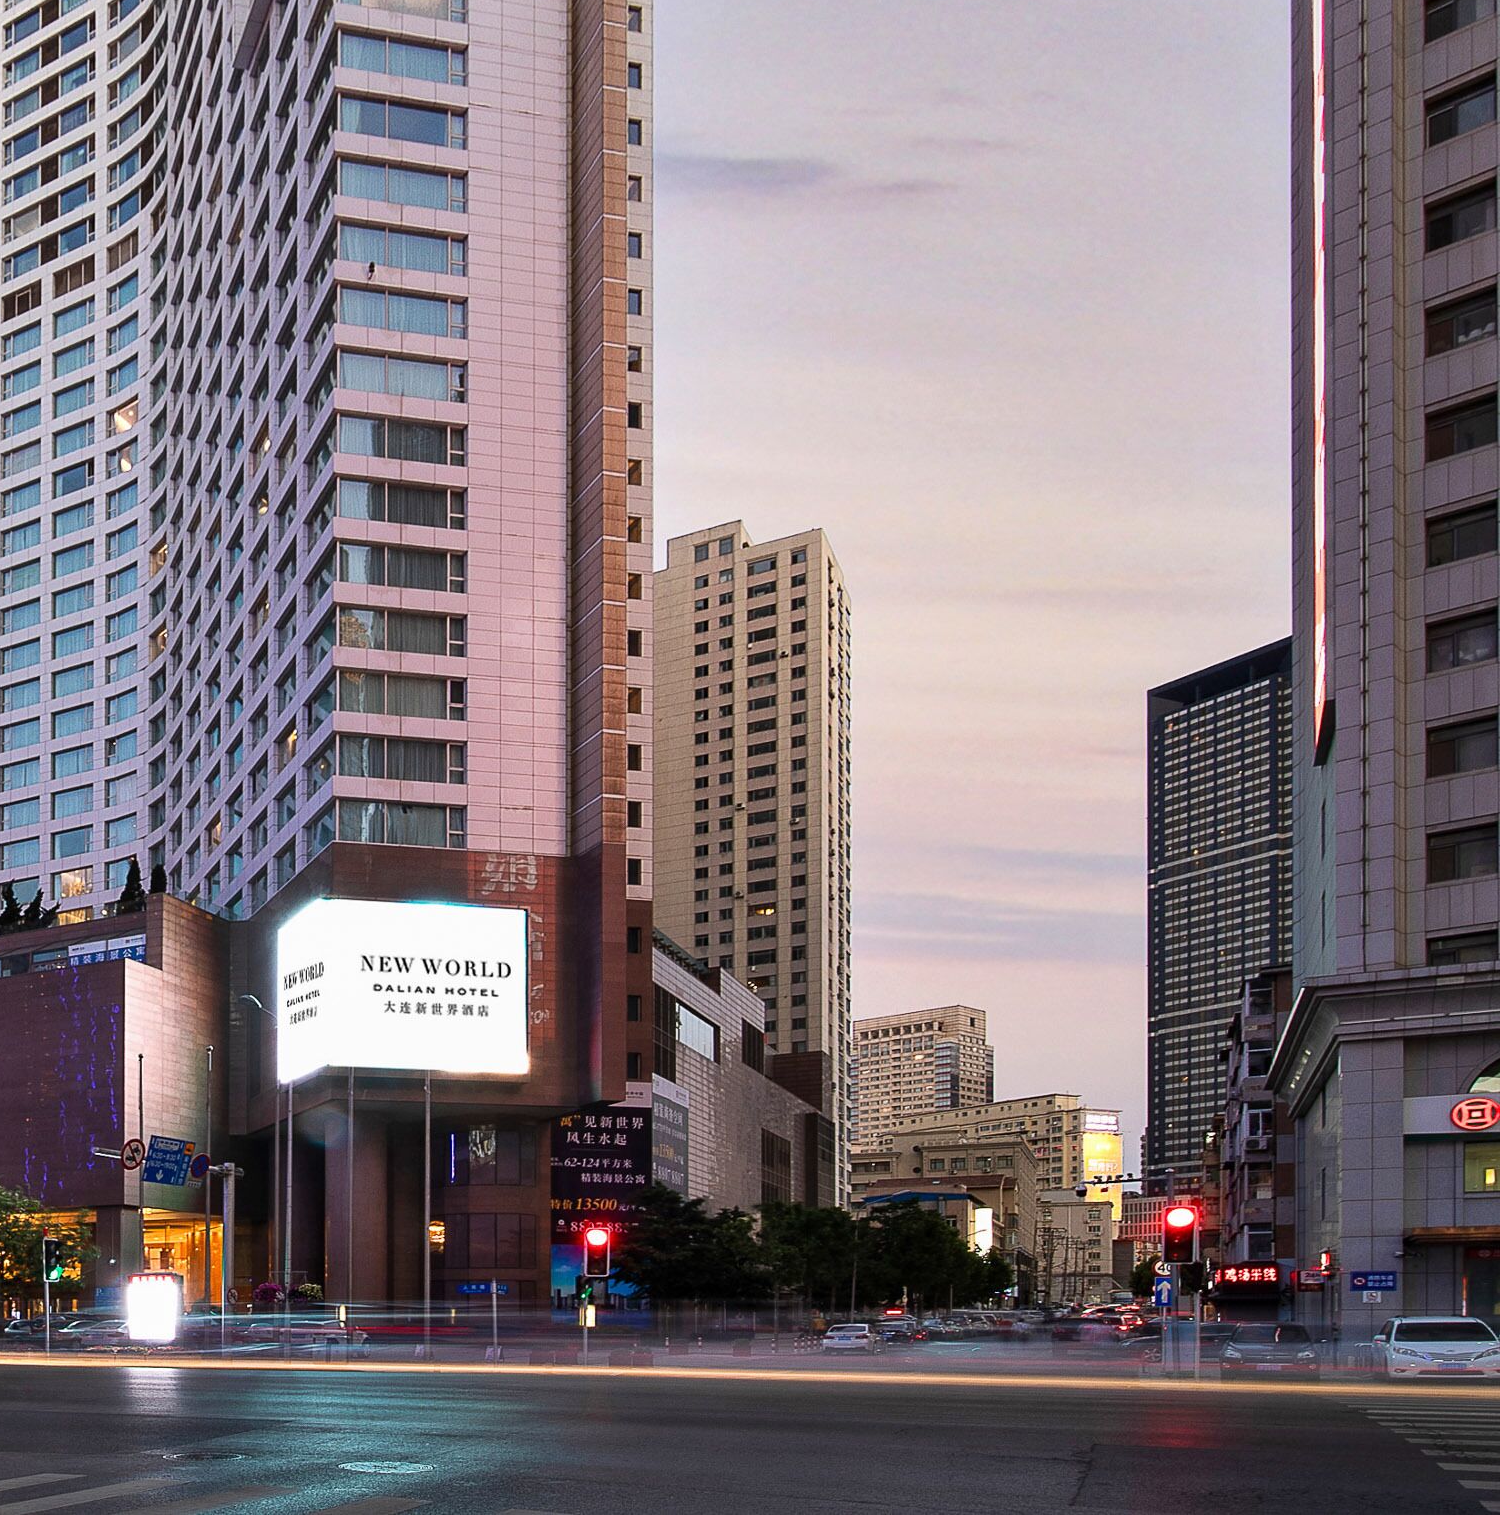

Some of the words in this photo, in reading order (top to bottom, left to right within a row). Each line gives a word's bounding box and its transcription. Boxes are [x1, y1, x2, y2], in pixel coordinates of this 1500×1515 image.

[360, 955, 414, 974] NEW
[421, 958, 512, 979] WORLD
[284, 971, 298, 991] NEW
[373, 983, 436, 994] DALIAN
[445, 987, 499, 997] HOTEL
[384, 1000, 489, 1017] 大连新世界酒店
[566, 1131, 627, 1146] 风生水起
[581, 1172, 646, 1185] 精装海景公寓
[575, 1197, 618, 1212] 13500
